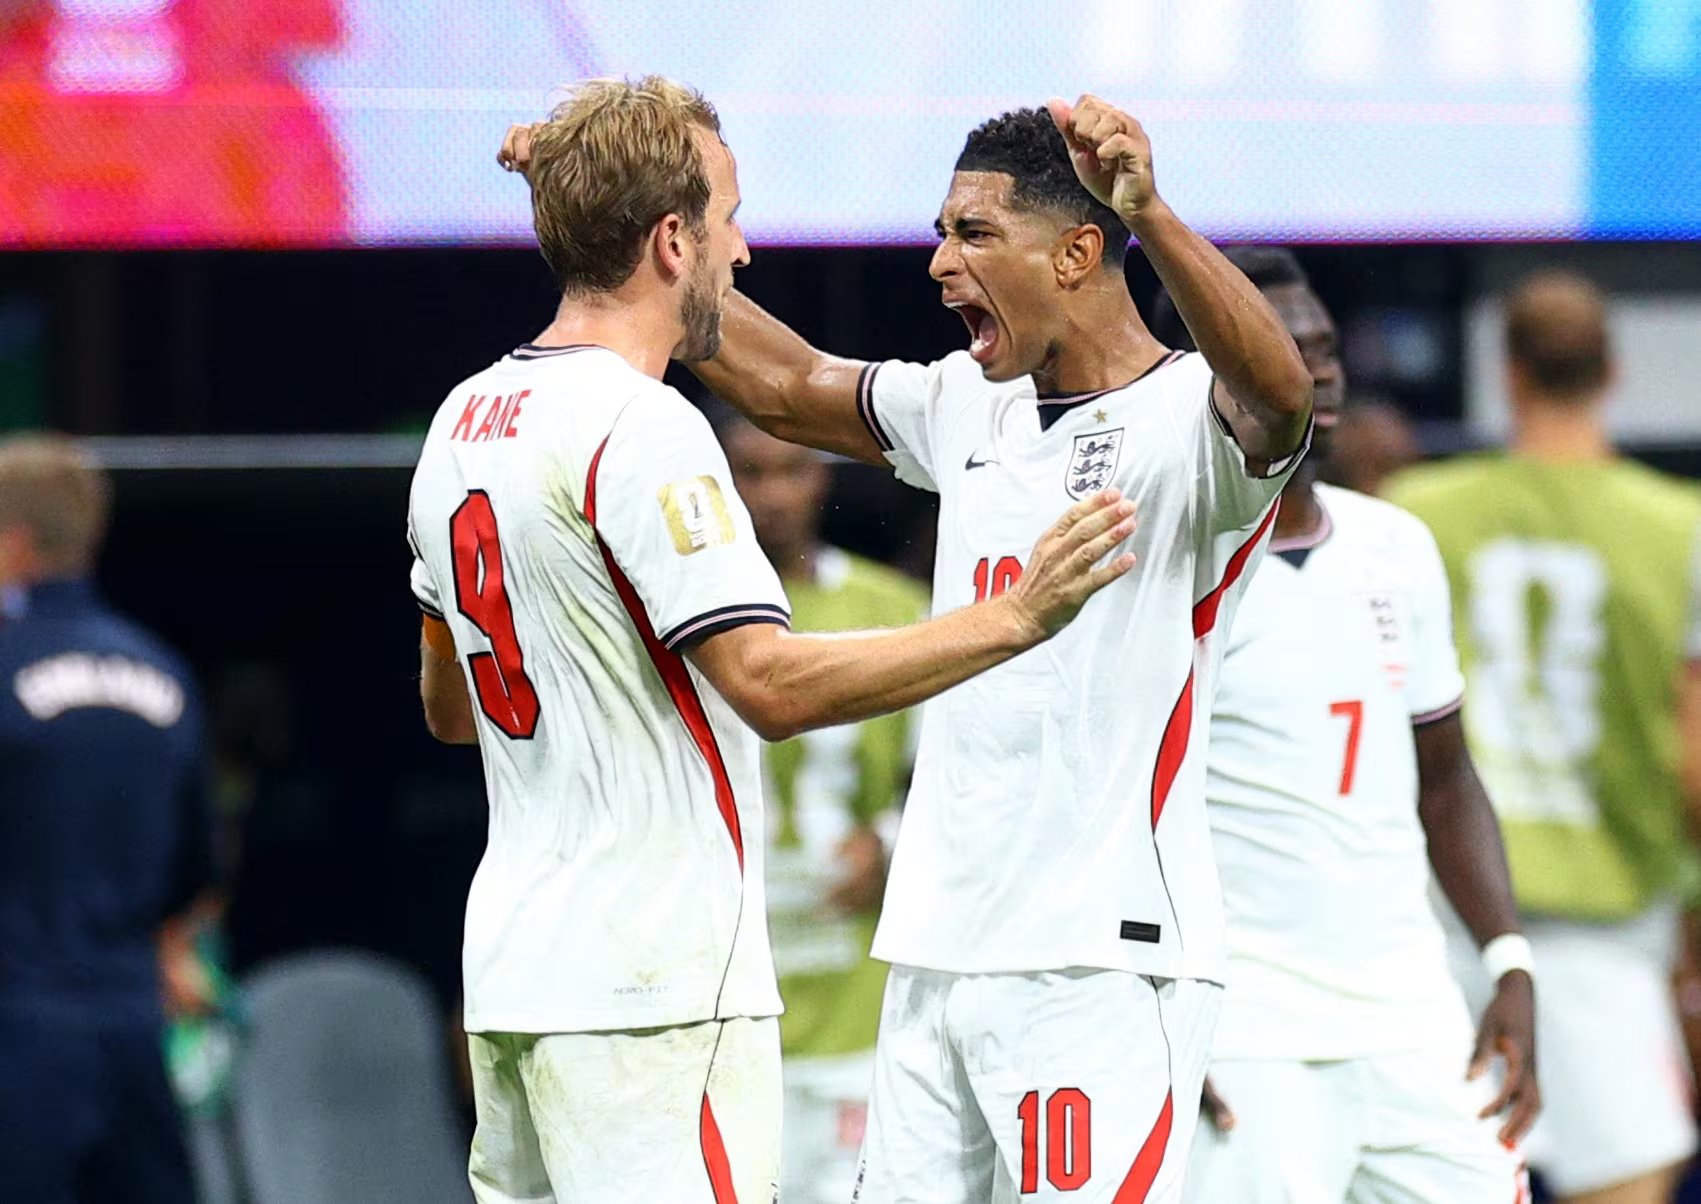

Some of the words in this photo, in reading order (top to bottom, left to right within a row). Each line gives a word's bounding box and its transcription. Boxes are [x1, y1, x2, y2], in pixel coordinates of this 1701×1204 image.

[450, 388, 532, 443] KANE
[449, 488, 541, 740] 9
[1329, 700, 1363, 796] 7
[1017, 1087, 1091, 1195] 10
